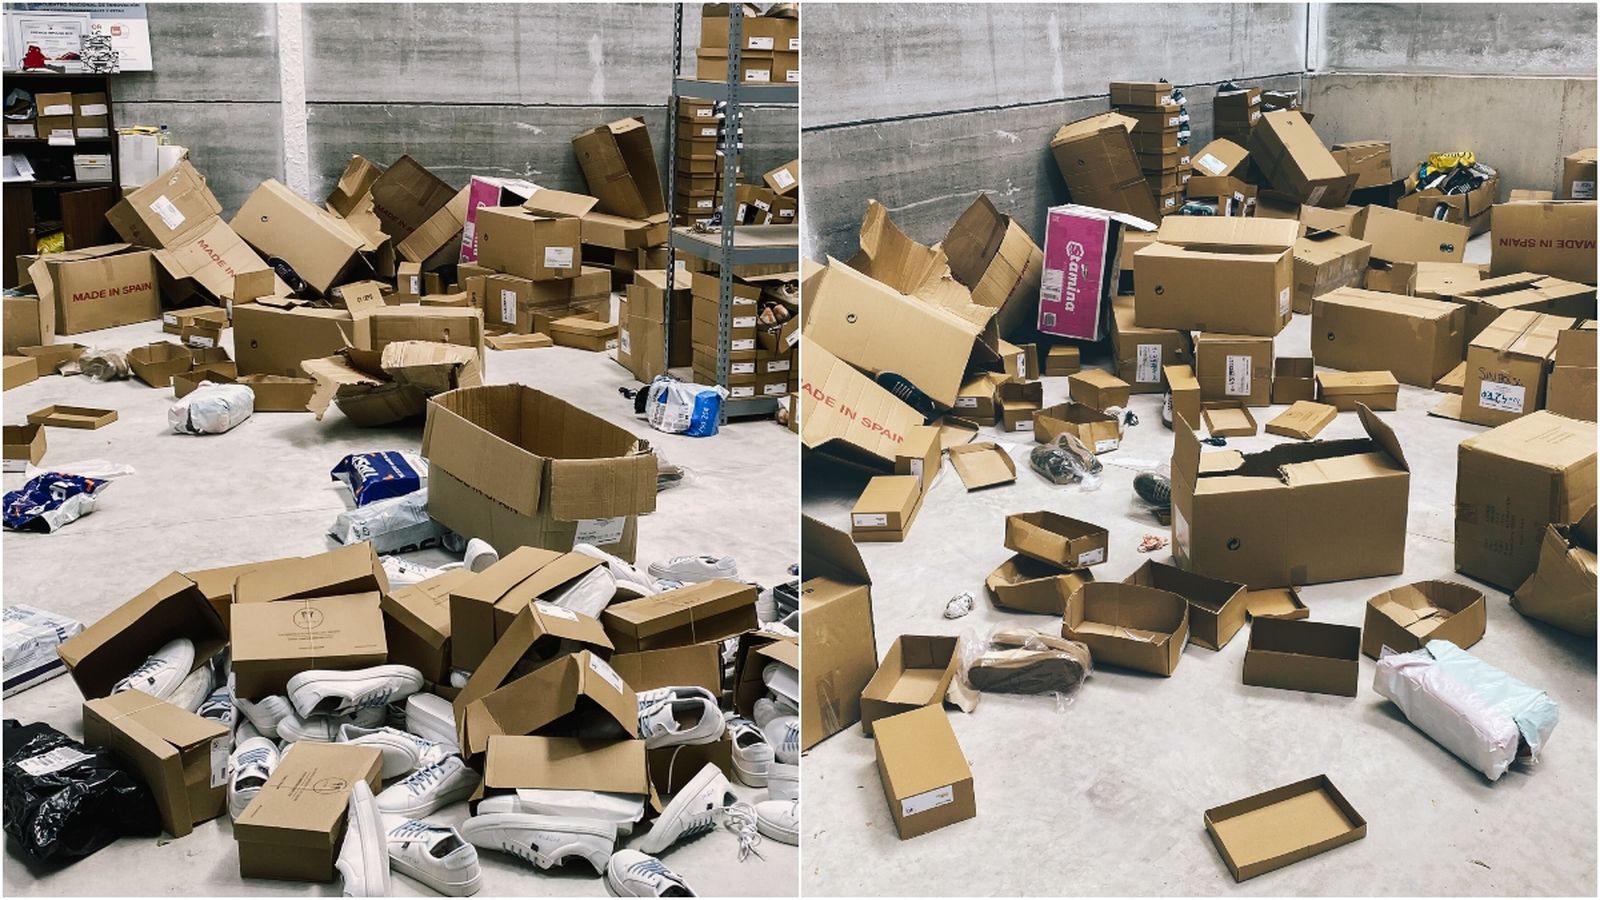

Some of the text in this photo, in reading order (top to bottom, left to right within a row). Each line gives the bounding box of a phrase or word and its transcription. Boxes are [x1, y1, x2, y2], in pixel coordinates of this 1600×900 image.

[197, 239, 225, 269] MADE
[1499, 238, 1596, 250] MADE IN SPAIN
[1064, 240, 1084, 313] Stamina
[72, 281, 153, 303] MADE IN SPAIN
[801, 377, 837, 409] ADE
[839, 403, 858, 421] IN
